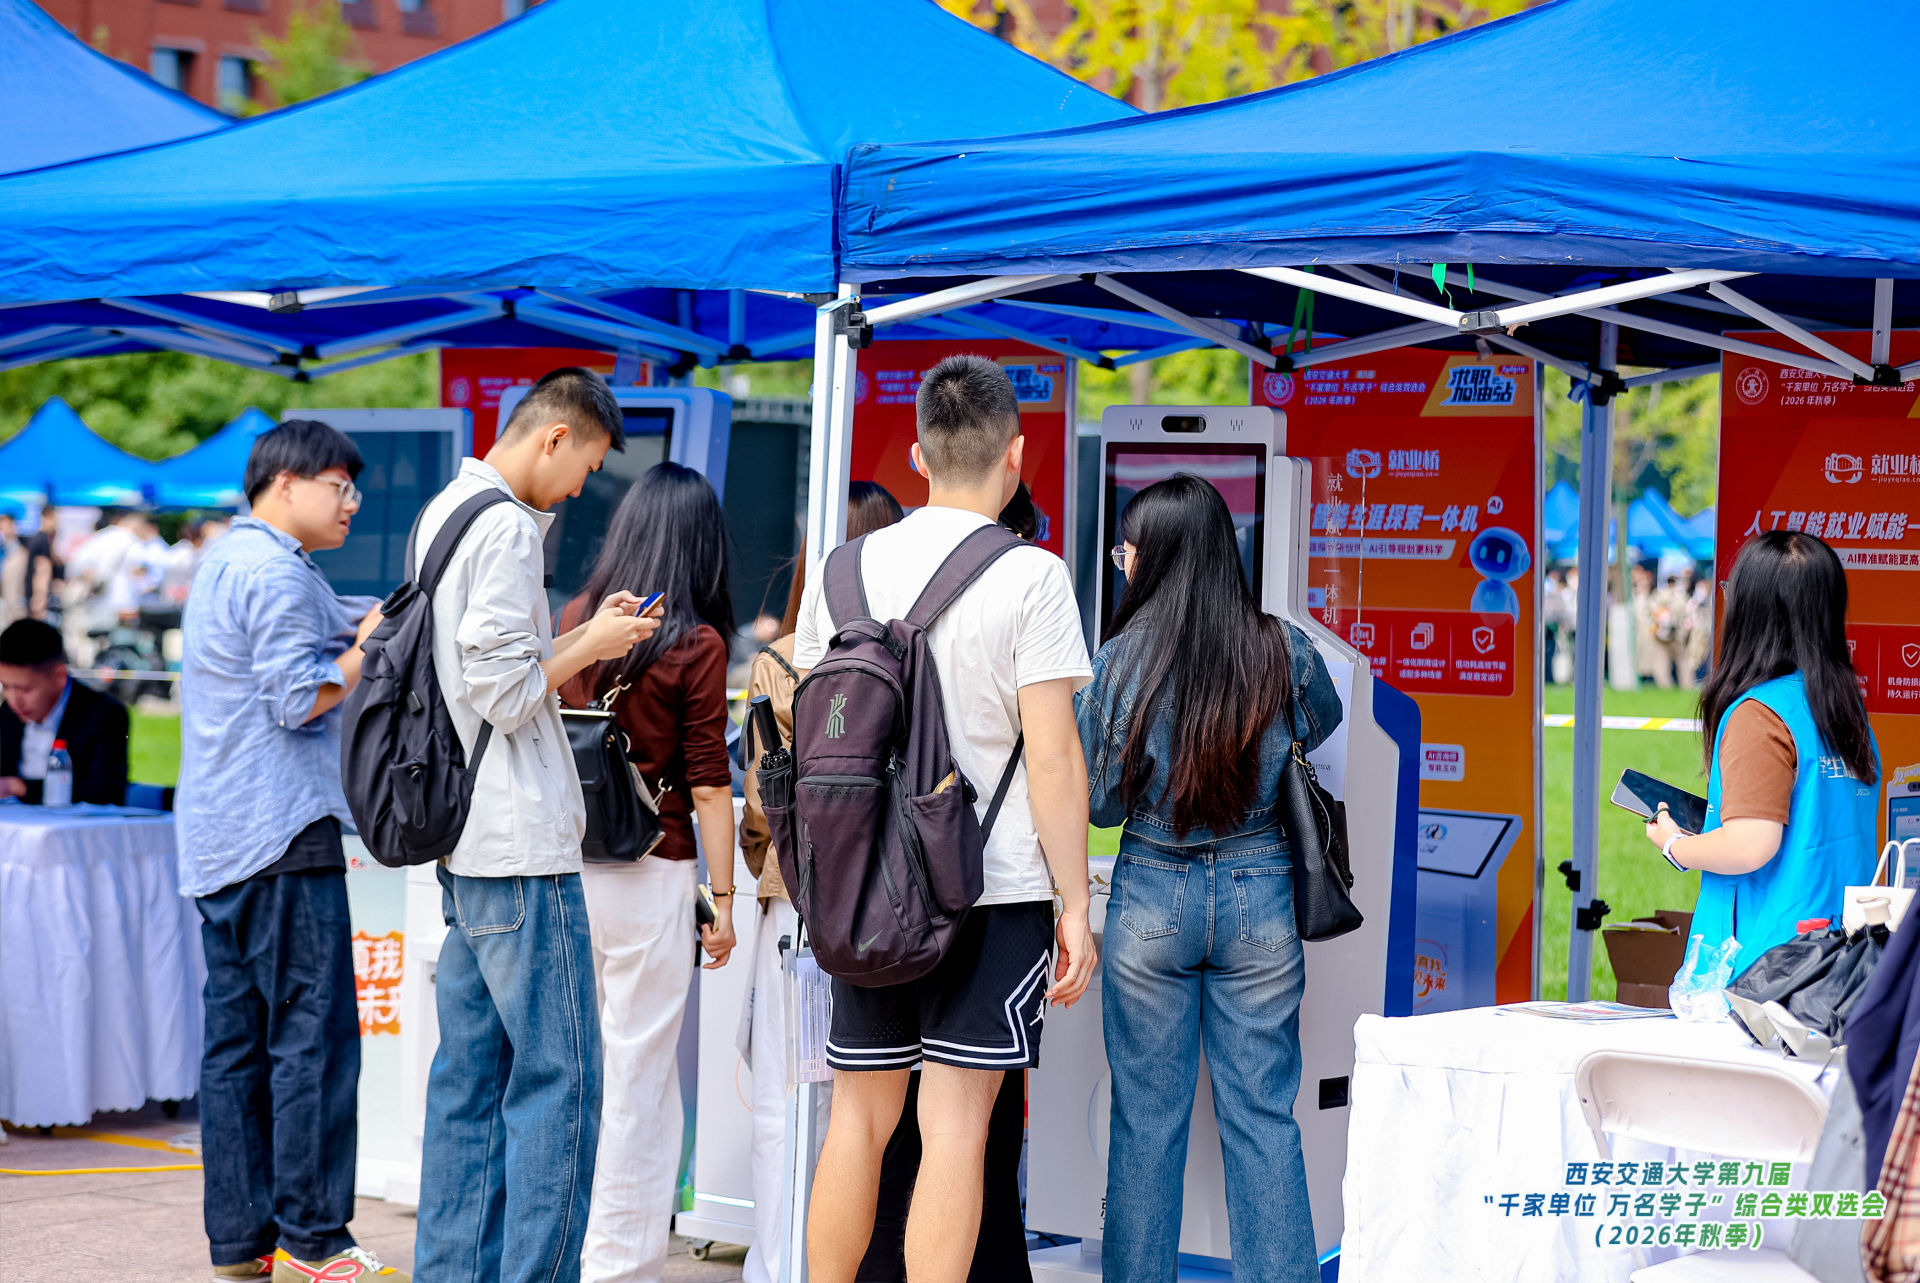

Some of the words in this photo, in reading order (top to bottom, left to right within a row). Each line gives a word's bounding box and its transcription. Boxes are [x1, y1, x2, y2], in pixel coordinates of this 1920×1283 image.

[1388, 449, 1440, 471] 就业桥
[1309, 503, 1479, 533] 智能生涯探索一体机
[1887, 676, 1920, 687] 机身防损
[1887, 689, 1920, 700] 持久运行
